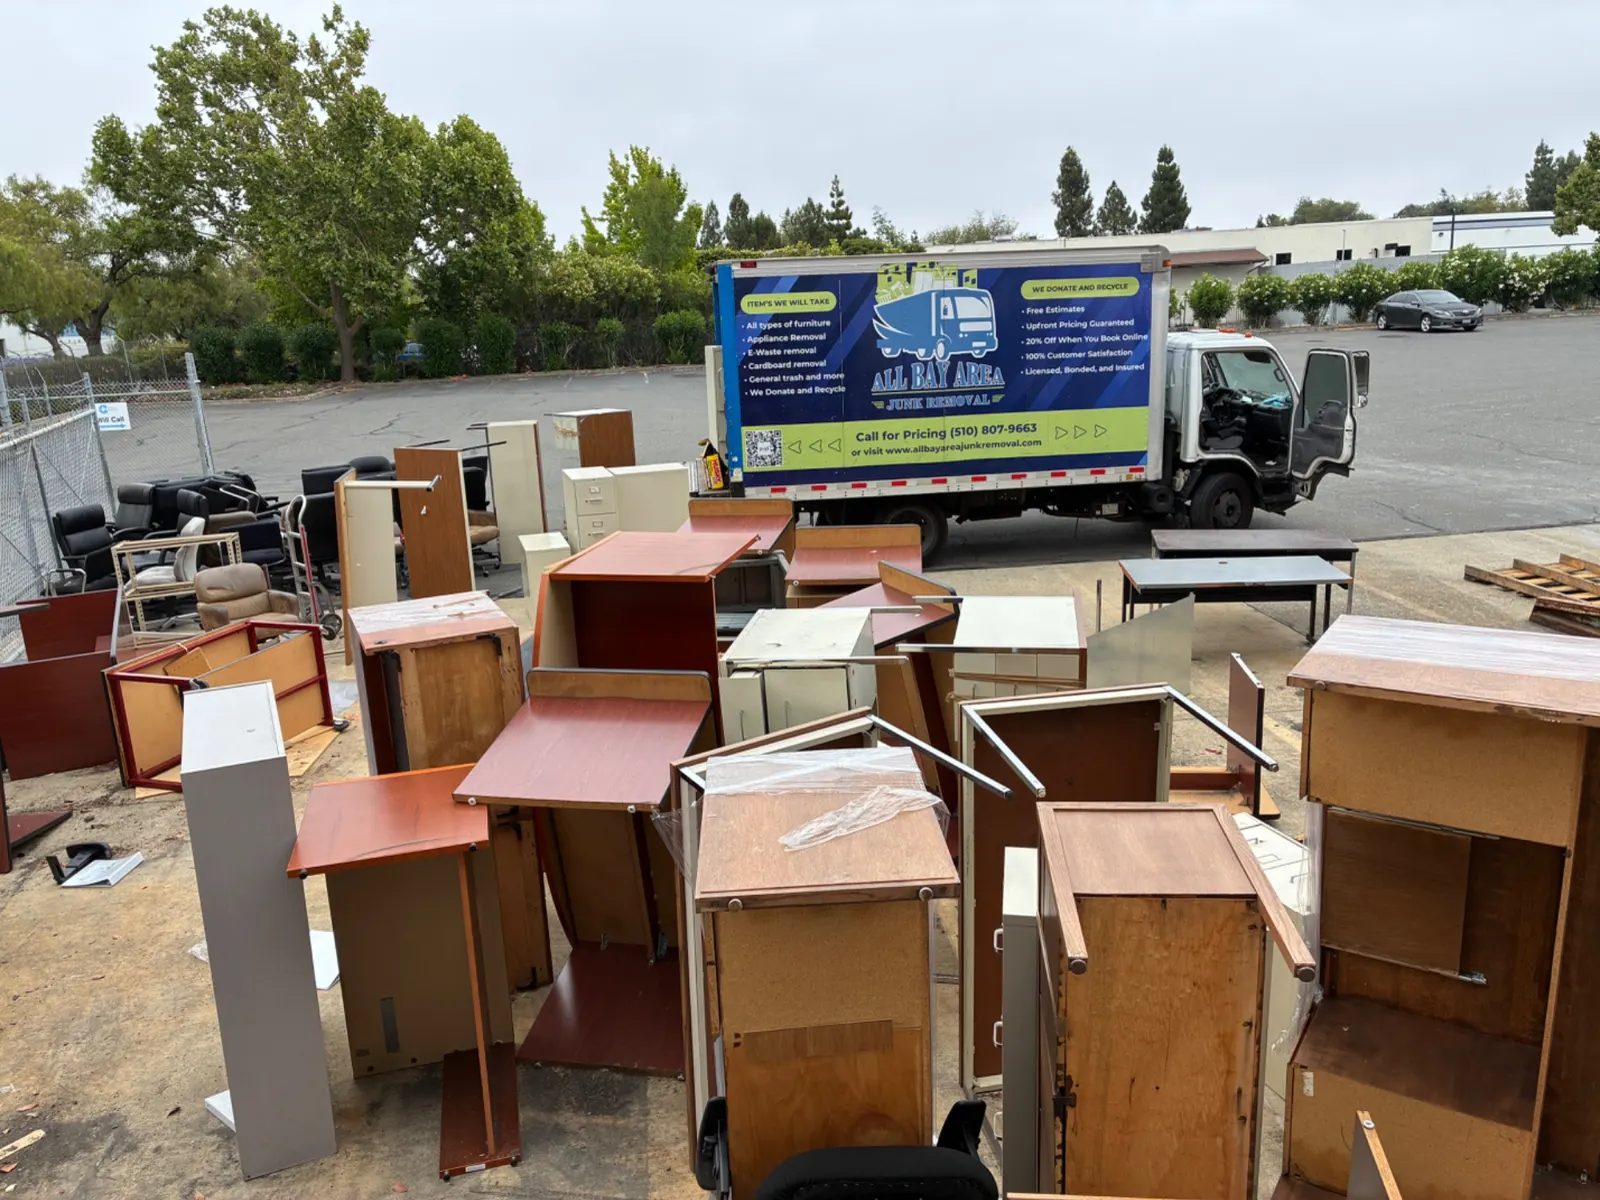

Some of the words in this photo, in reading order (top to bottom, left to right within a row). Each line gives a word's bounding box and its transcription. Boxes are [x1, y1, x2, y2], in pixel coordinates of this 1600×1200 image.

[1046, 284, 1077, 292] DONATE
[1026, 307, 1044, 315] Free
[1045, 305, 1085, 314] Estimates
[746, 322, 758, 330] All
[759, 322, 782, 331] types
[783, 320, 793, 328] of
[794, 318, 831, 328] furniture
[1026, 322, 1057, 331] Upfront
[1059, 320, 1087, 329] Pricing
[1089, 318, 1135, 328] Guaranteed
[747, 335, 789, 345] Appliance
[790, 332, 827, 342] Removal
[1025, 337, 1043, 345] 20%
[1043, 336, 1057, 344] Off
[1100, 333, 1121, 342] Book
[1122, 332, 1149, 340] Online
[748, 348, 782, 357] E-Waste
[783, 346, 817, 355] removal
[1025, 352, 1046, 360] 100%
[1046, 350, 1086, 359] Customer
[1087, 348, 1133, 358] Satisfaction
[748, 361, 792, 370] Cardboard
[793, 359, 827, 368] removal
[1025, 367, 1063, 375] Licensed,
[1064, 366, 1098, 374] Bonded,
[1098, 364, 1114, 372] and
[1115, 363, 1145, 371] Insured
[748, 375, 781, 384] General
[782, 373, 804, 382] trash
[805, 373, 822, 381] and
[823, 372, 845, 380] more
[871, 365, 908, 392] ALL
[911, 360, 950, 390] BAY
[952, 360, 1006, 388] AREA
[749, 389, 764, 397] We
[765, 387, 795, 396] Donate
[797, 386, 813, 394] and
[814, 385, 847, 395] Recycle
[886, 397, 924, 411] JUNK
[926, 393, 991, 409] REMOVAL
[110, 415, 125, 423] Call
[855, 431, 879, 443] Call
[882, 430, 900, 441] for
[903, 427, 947, 441] Pricing
[950, 426, 978, 440] (510)
[981, 423, 1037, 435] 807-9663
[851, 449, 861, 457] or
[863, 446, 884, 456] visit
[885, 439, 1042, 455] www.allbayareajunkremoval.com
